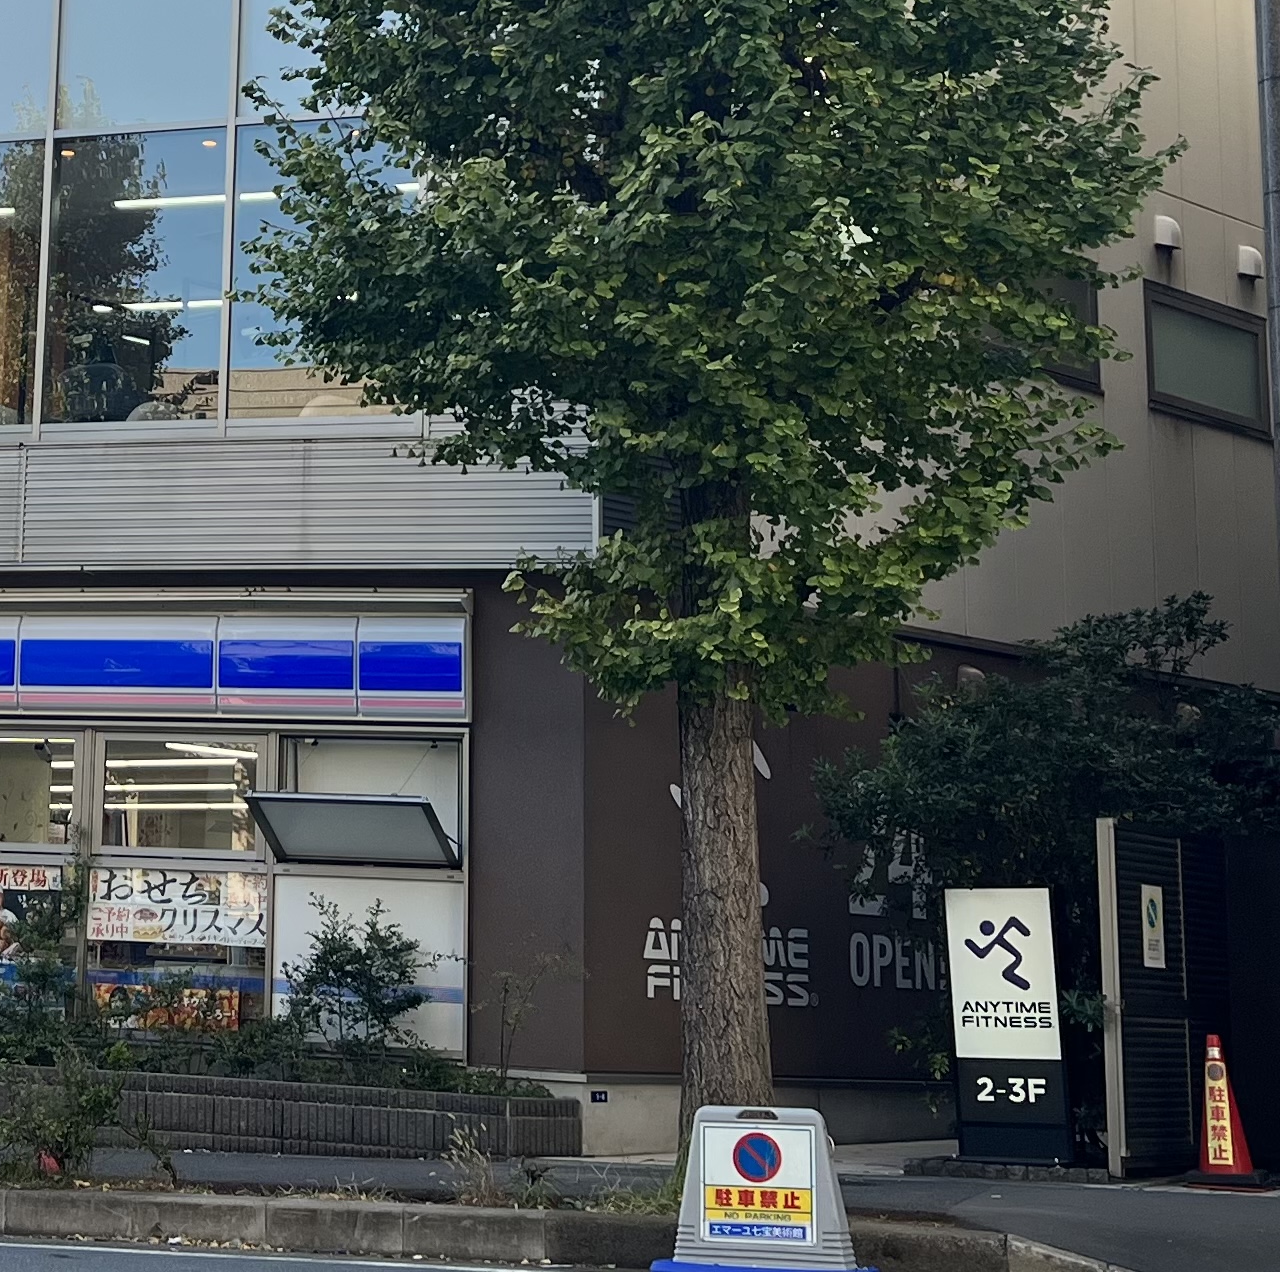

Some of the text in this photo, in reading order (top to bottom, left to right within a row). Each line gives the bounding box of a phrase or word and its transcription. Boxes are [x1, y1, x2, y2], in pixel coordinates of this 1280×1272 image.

[100, 868, 208, 905] おせち
[646, 963, 810, 1007] FISS
[962, 1000, 1051, 1014] ANYTIME
[962, 1015, 1053, 1029] FITNESS
[976, 1076, 1046, 1103] 2-3F
[1208, 1085, 1229, 1161] 駐車禁止
[714, 1188, 801, 1210] 駐車禁止
[724, 1211, 792, 1222] NO PARKING
